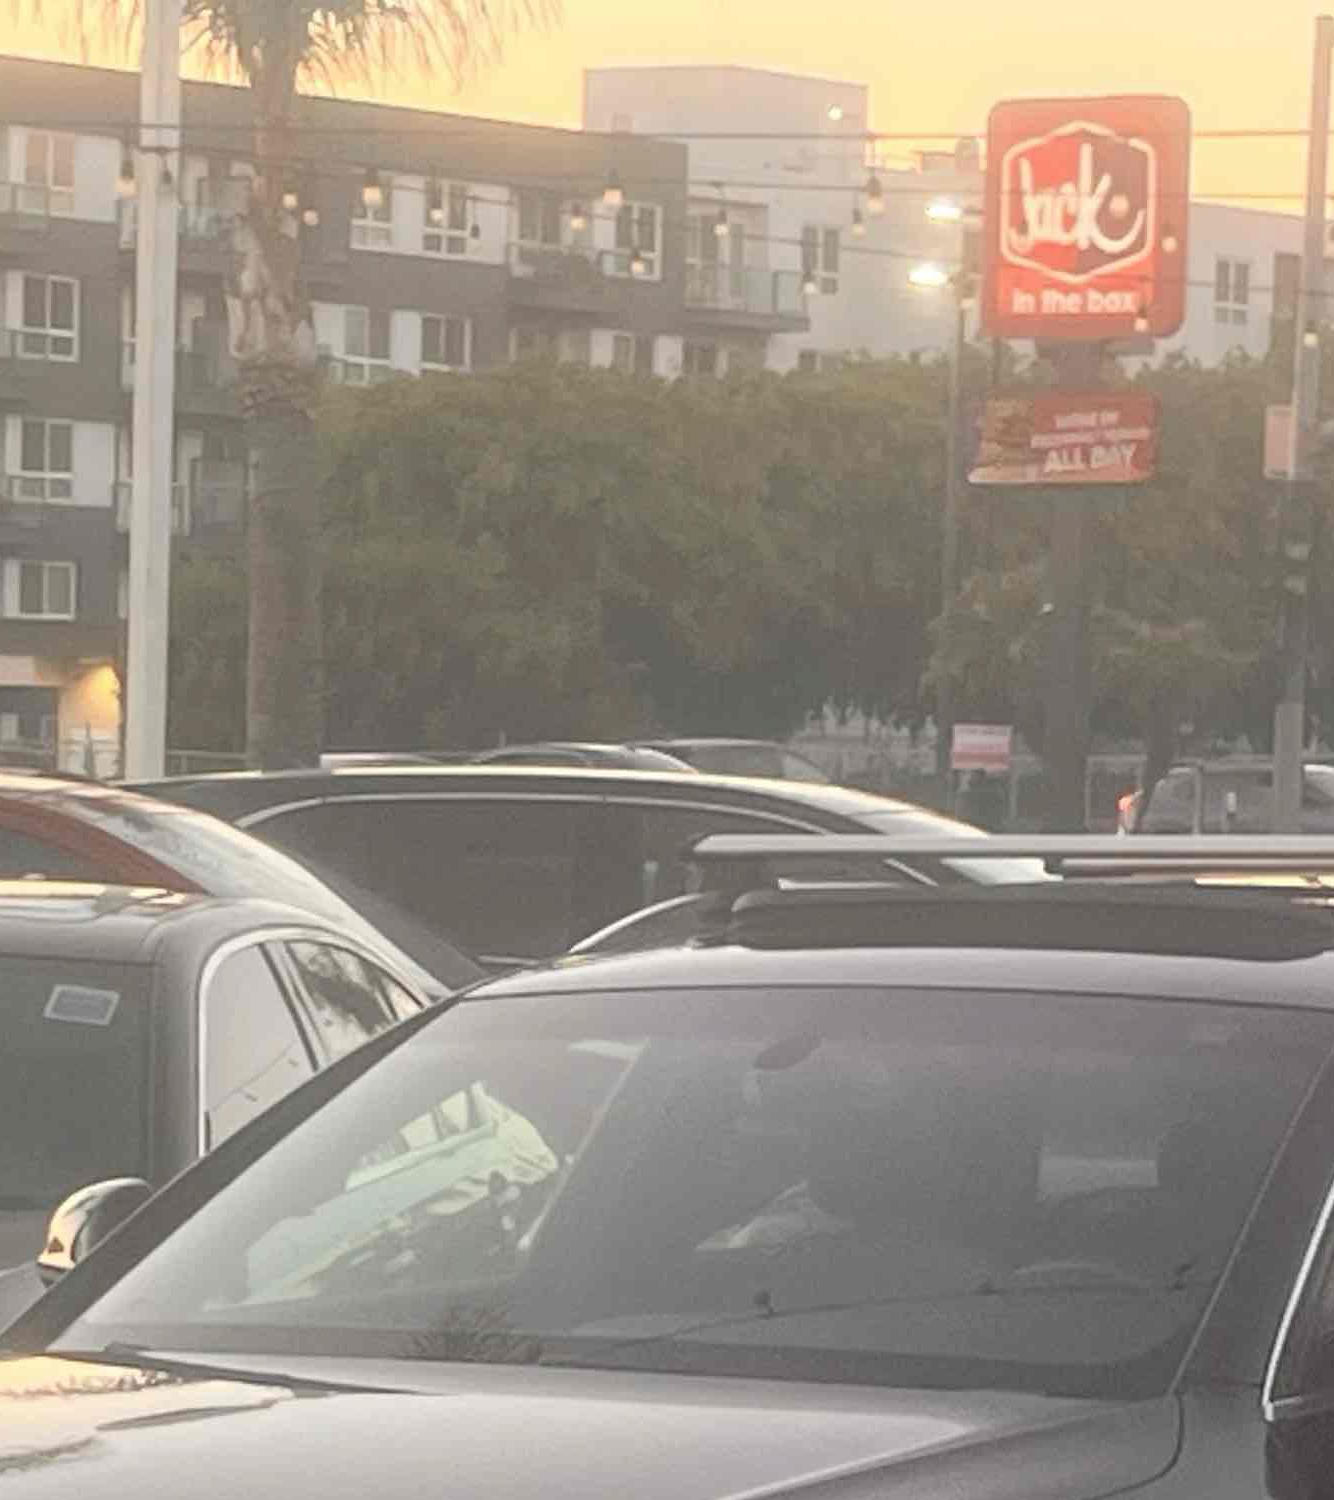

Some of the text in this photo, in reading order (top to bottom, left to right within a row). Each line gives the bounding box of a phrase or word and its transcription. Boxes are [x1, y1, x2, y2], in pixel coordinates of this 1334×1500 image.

[1009, 142, 1146, 254] Jack
[1012, 287, 1138, 313] in the box
[1044, 445, 1086, 473] ALL
